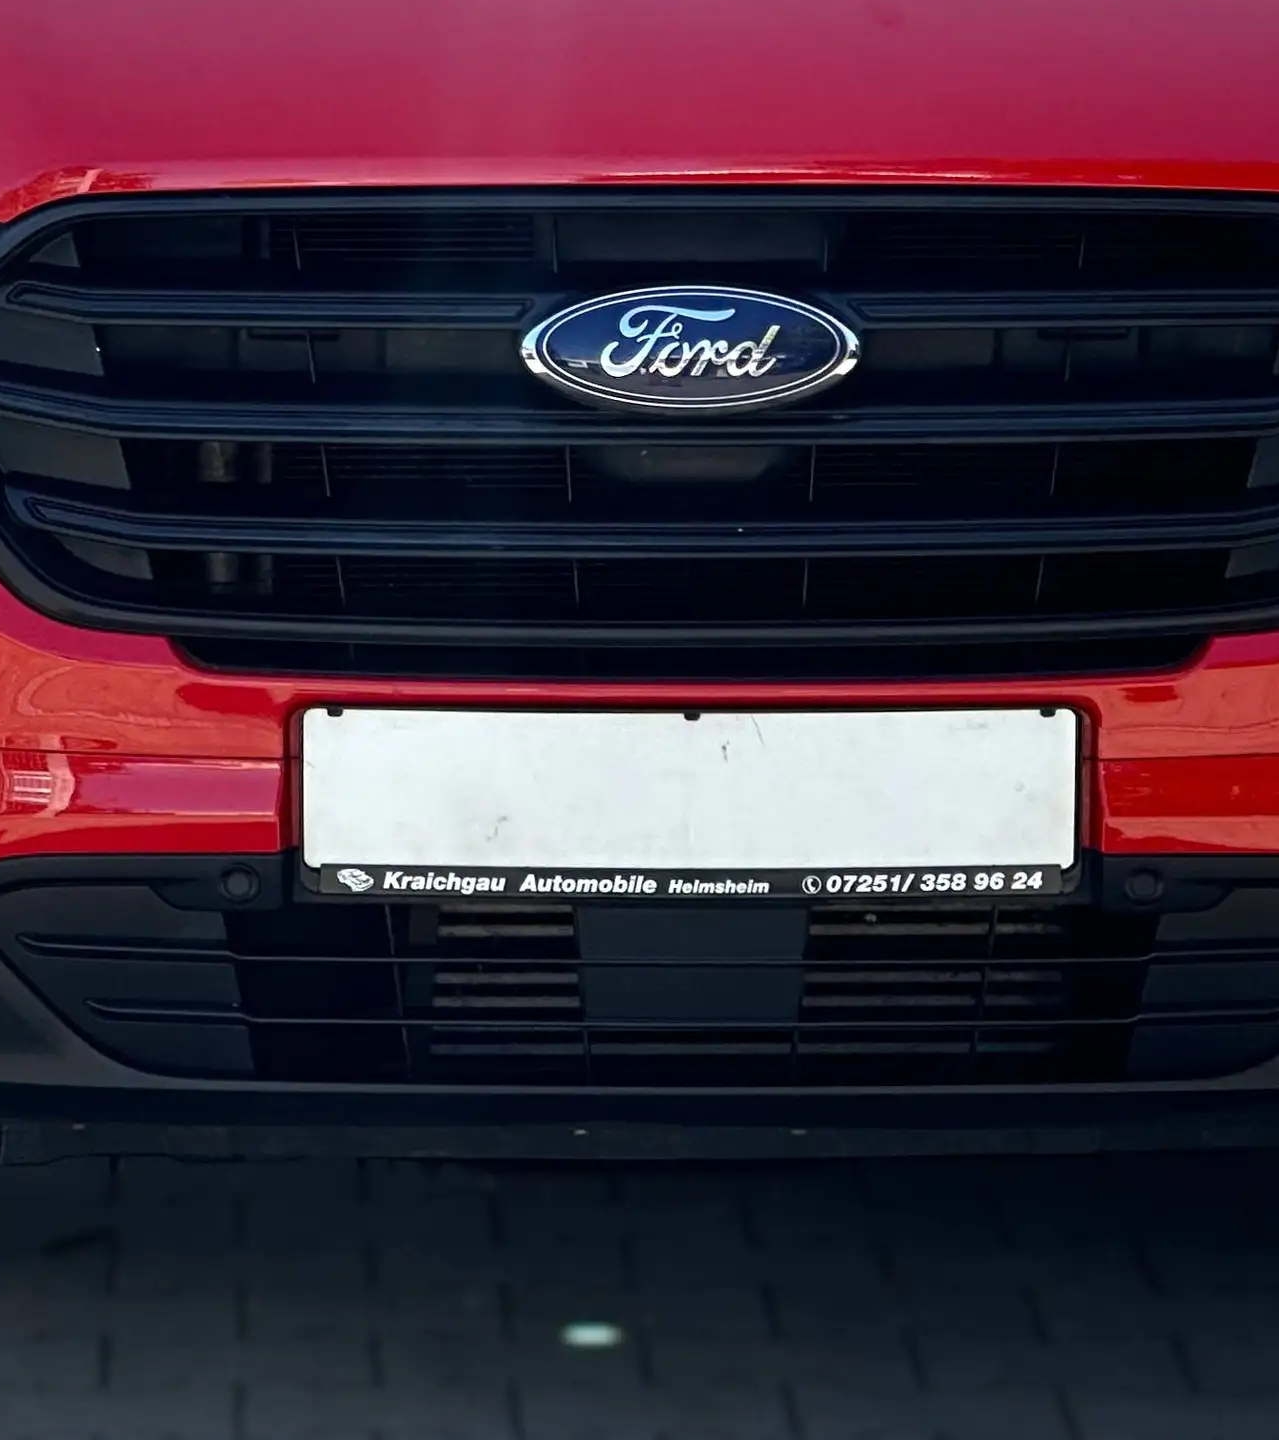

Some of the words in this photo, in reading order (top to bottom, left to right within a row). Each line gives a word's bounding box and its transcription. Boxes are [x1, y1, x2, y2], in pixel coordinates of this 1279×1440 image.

[600, 304, 781, 378] Ford
[382, 871, 506, 895] Kraichgau
[518, 873, 658, 894] Automobile
[668, 878, 770, 894] Helmsheim
[825, 873, 916, 893] 07251/
[919, 872, 967, 892] 358
[973, 871, 1006, 891] 96
[1010, 871, 1043, 890] 24
